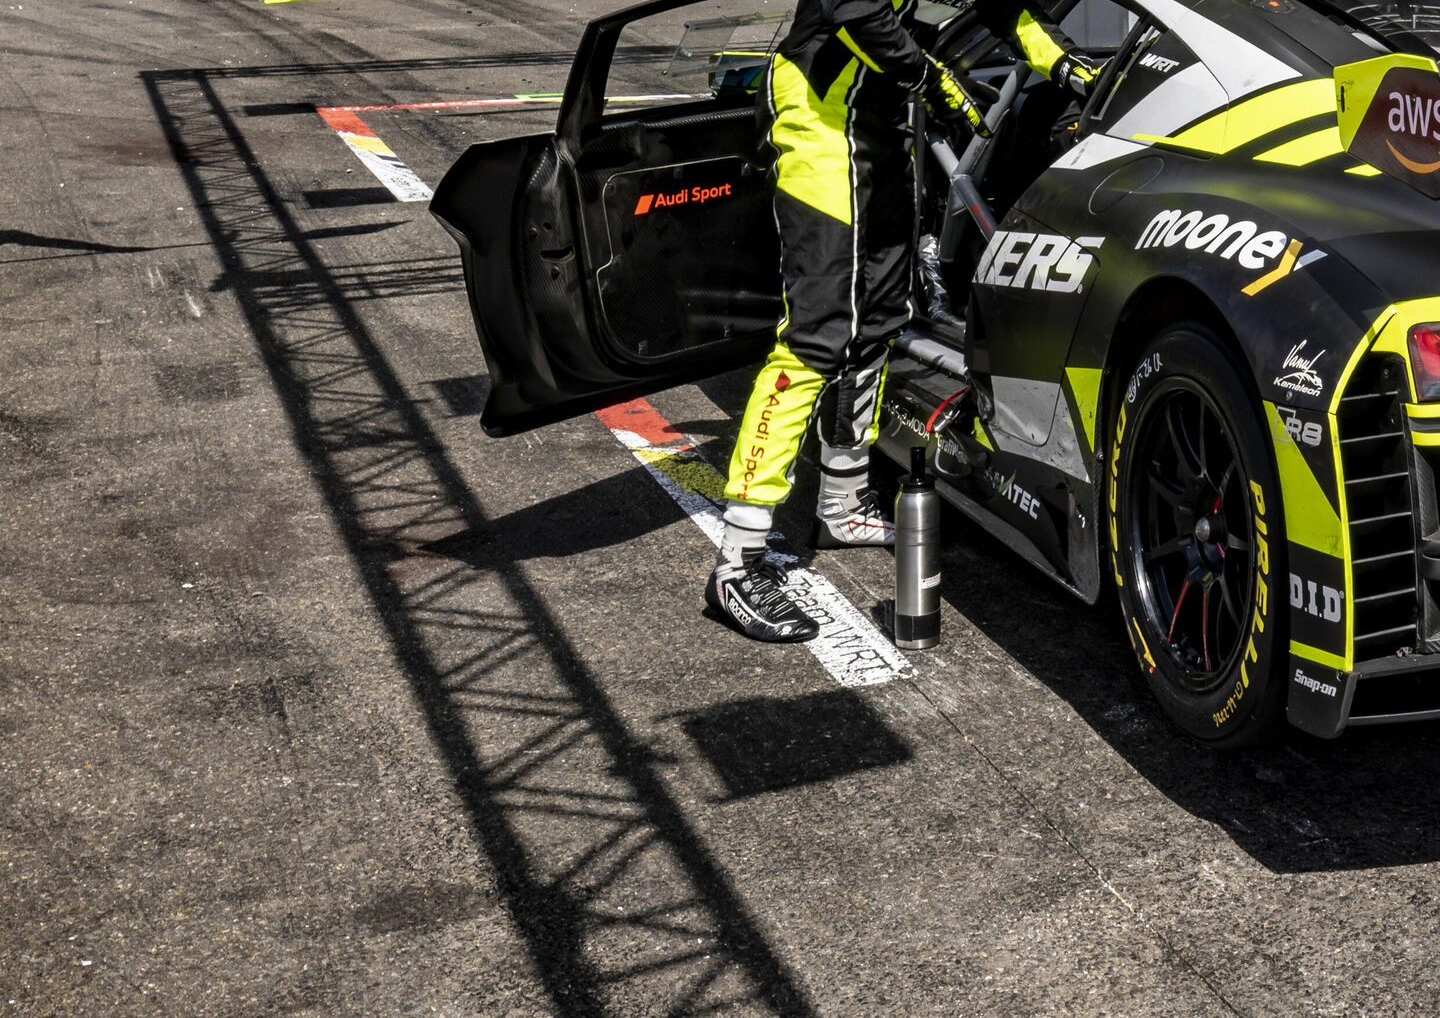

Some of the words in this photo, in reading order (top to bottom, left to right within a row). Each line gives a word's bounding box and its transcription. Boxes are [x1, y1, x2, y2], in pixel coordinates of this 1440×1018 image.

[1139, 52, 1180, 73] WRT
[654, 193, 688, 208] Audi
[691, 183, 731, 203] Sport
[1135, 209, 1328, 297] mooney
[1273, 377, 1322, 397] Kameleon
[755, 394, 780, 445] Audi
[1286, 416, 1322, 447] R8
[737, 446, 765, 500] Sport
[1249, 479, 1269, 689] PIRELLI
[729, 598, 751, 625] sparco
[824, 627, 894, 673] WRT
[1294, 667, 1337, 698] Snap-on
